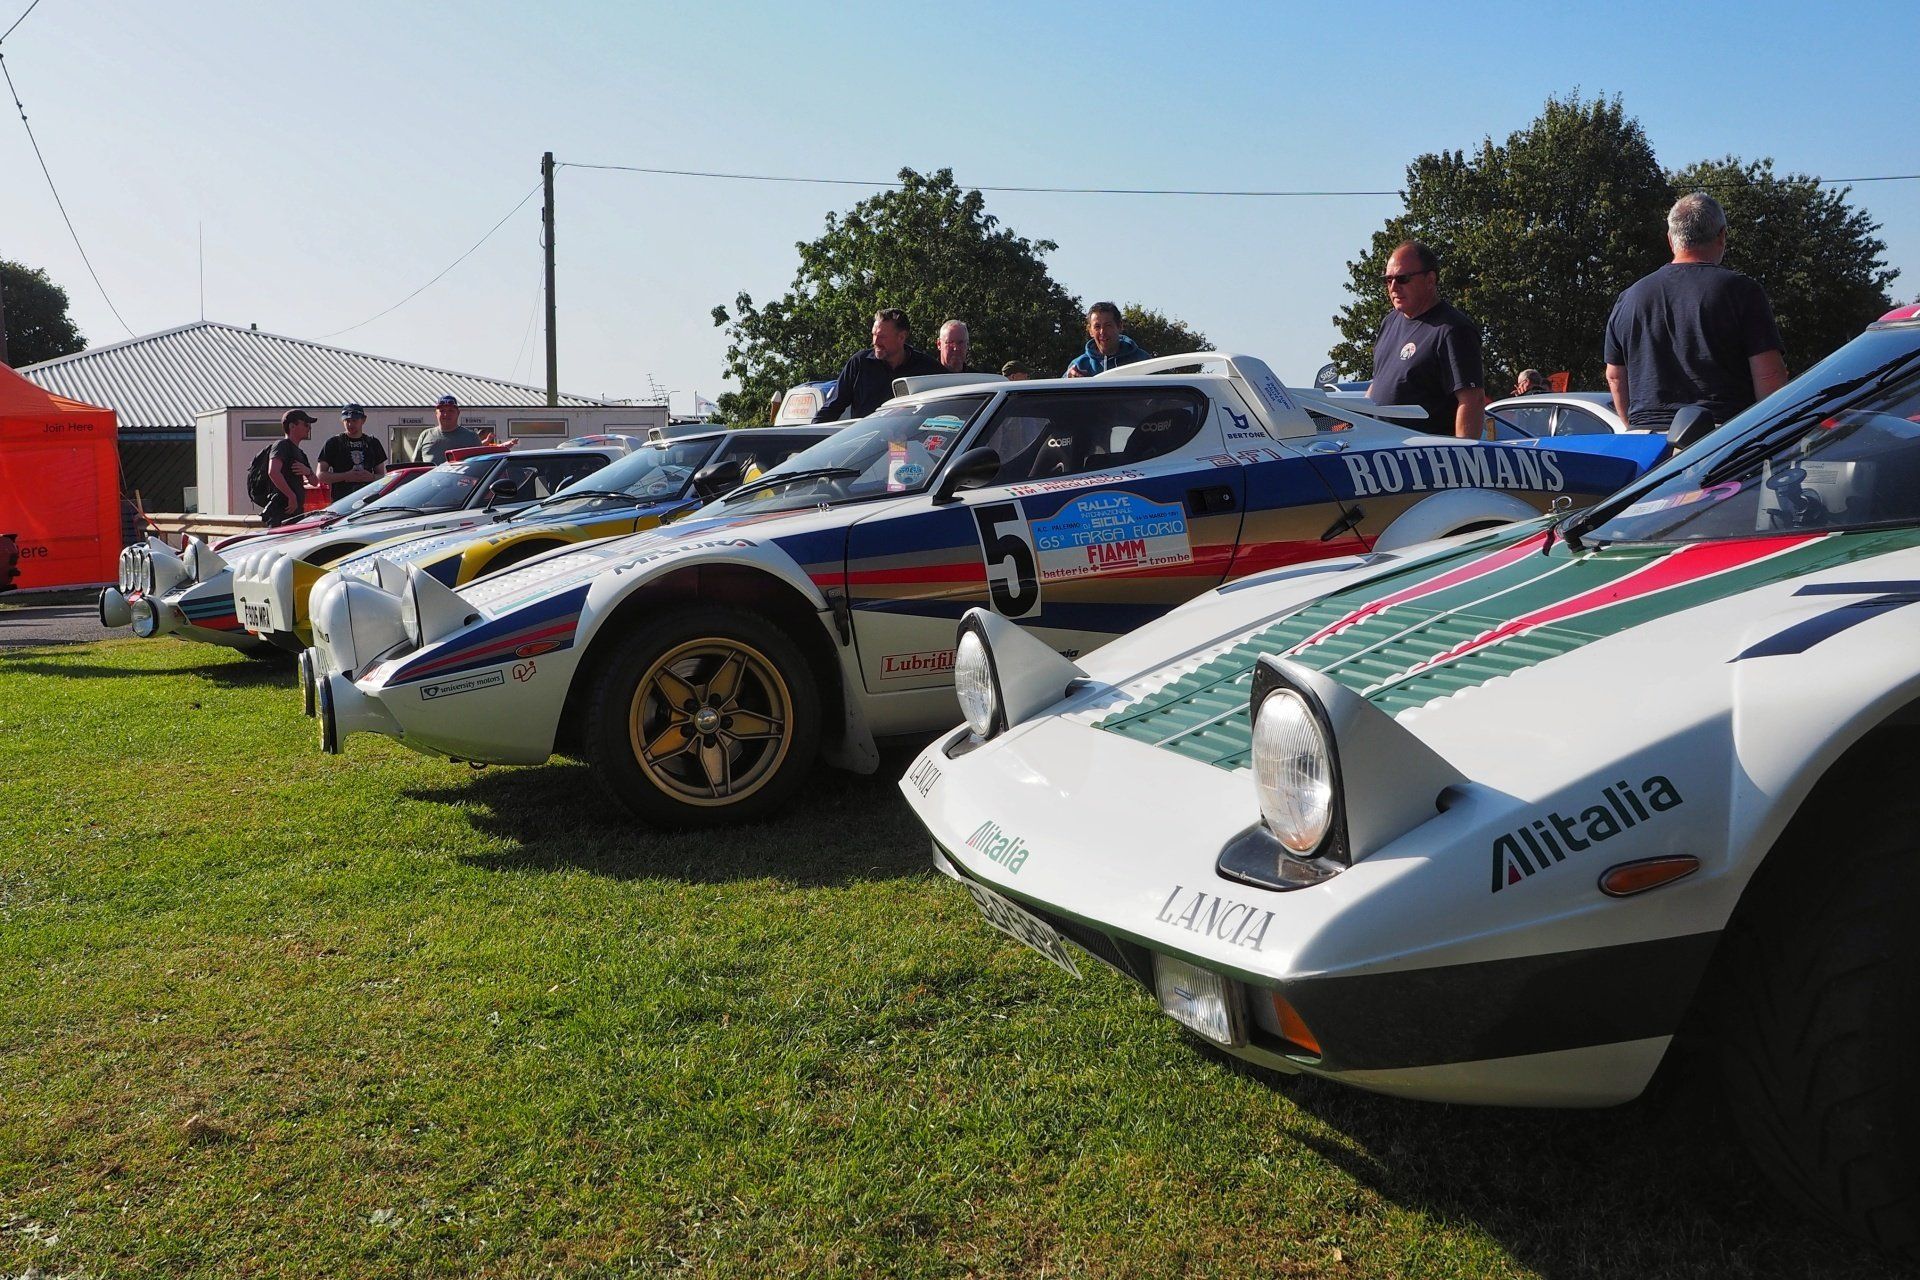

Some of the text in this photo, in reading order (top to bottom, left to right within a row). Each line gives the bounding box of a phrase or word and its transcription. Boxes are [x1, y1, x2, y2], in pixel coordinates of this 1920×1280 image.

[43, 422, 94, 433] Join Here
[1227, 431, 1266, 440] BERTONE
[1342, 446, 1564, 497] ROTHMANS
[1043, 475, 1124, 492] PREGLIASCO
[1078, 496, 1131, 512] RALLYE
[1052, 521, 1081, 531] PALERMO
[1092, 514, 1136, 529] SICILIA
[1072, 527, 1126, 545] TARGA
[1133, 520, 1184, 538] FLORIO
[17, 545, 49, 559] ere
[974, 502, 1039, 618] 5
[1086, 538, 1147, 564] FIAMM
[1149, 552, 1190, 565] trombe
[1042, 565, 1089, 579] batterie
[885, 651, 958, 673] Lubrifil
[440, 674, 501, 694] university motors
[909, 755, 942, 798] LANCIA
[1492, 775, 1684, 893] Alitalia
[965, 820, 1029, 875] Alitalia
[1155, 885, 1276, 952] LANCIA
